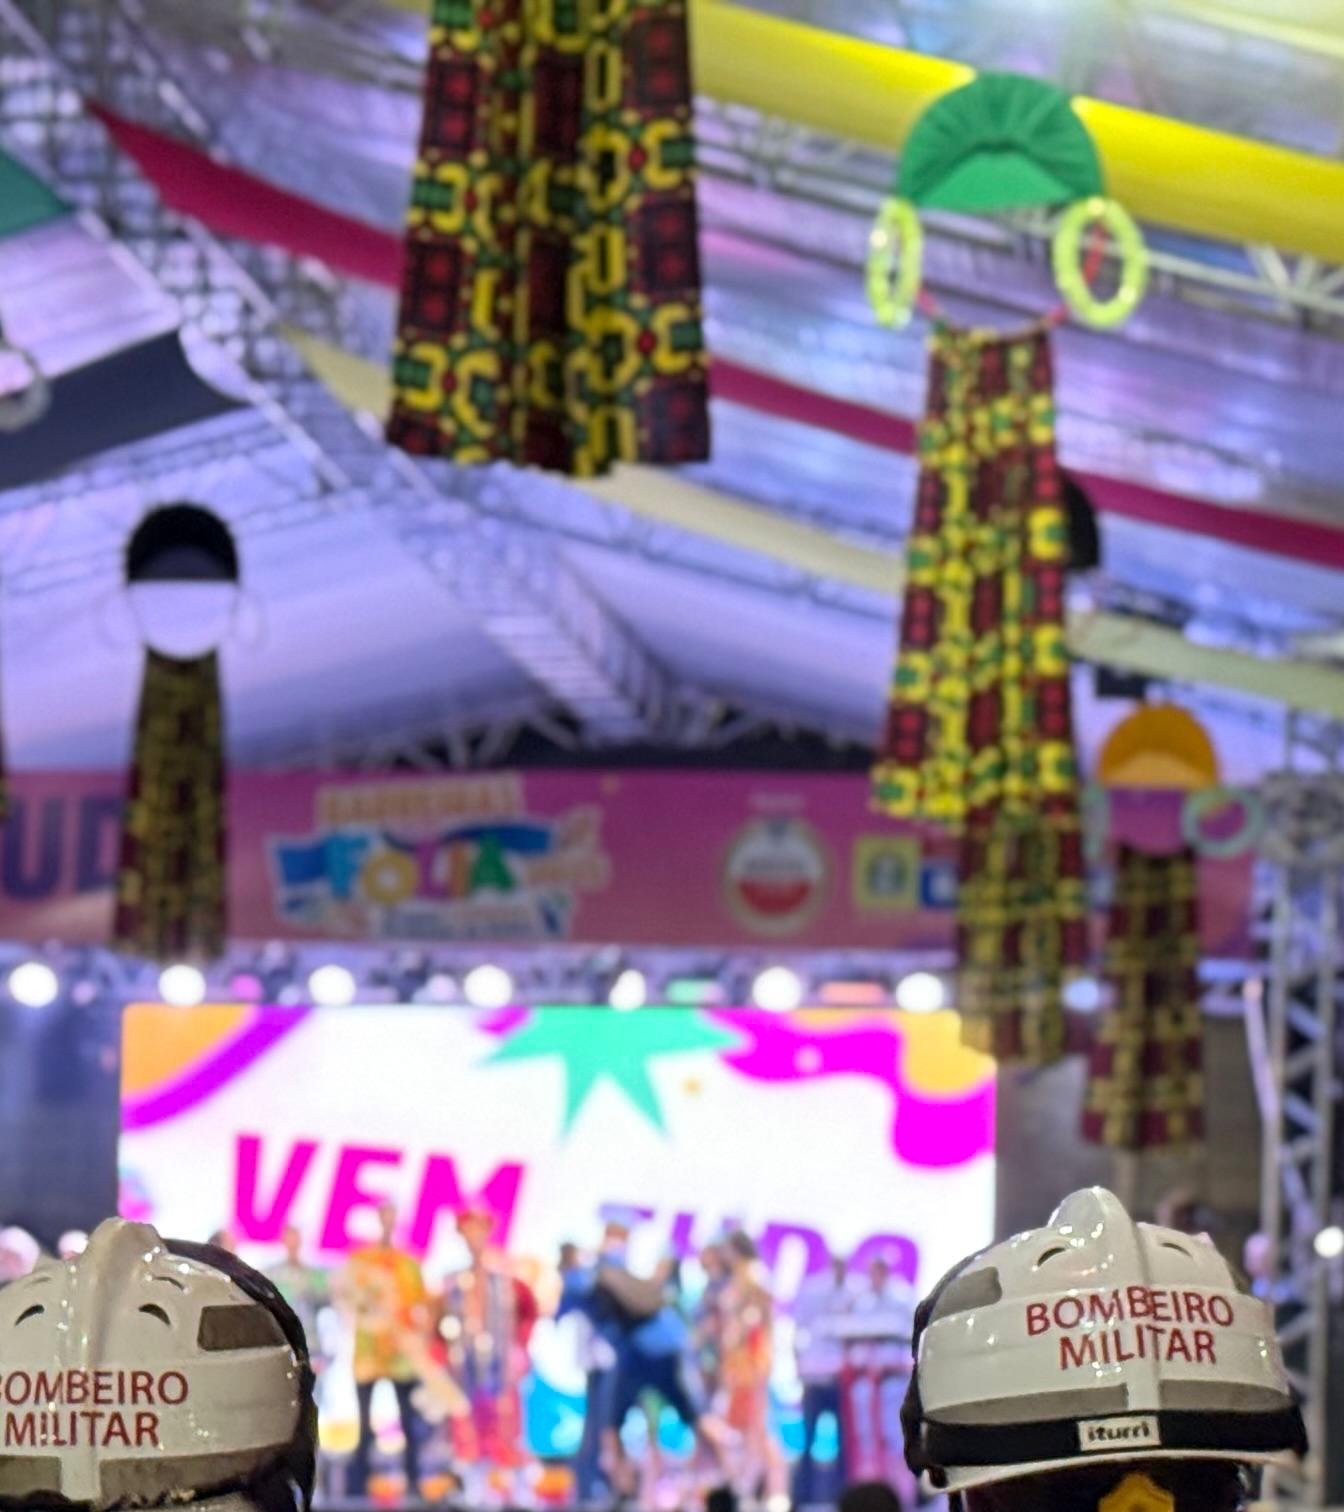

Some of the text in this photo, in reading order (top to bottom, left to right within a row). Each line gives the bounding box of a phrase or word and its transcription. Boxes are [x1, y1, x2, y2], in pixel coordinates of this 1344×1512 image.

[233, 1132, 526, 1260] VEM
[1024, 1285, 1235, 1337] BOMBEIRO
[1058, 1324, 1217, 1371] MILITAR
[3, 1410, 161, 1448] MILITAR
[1088, 1420, 1150, 1442] iturri
